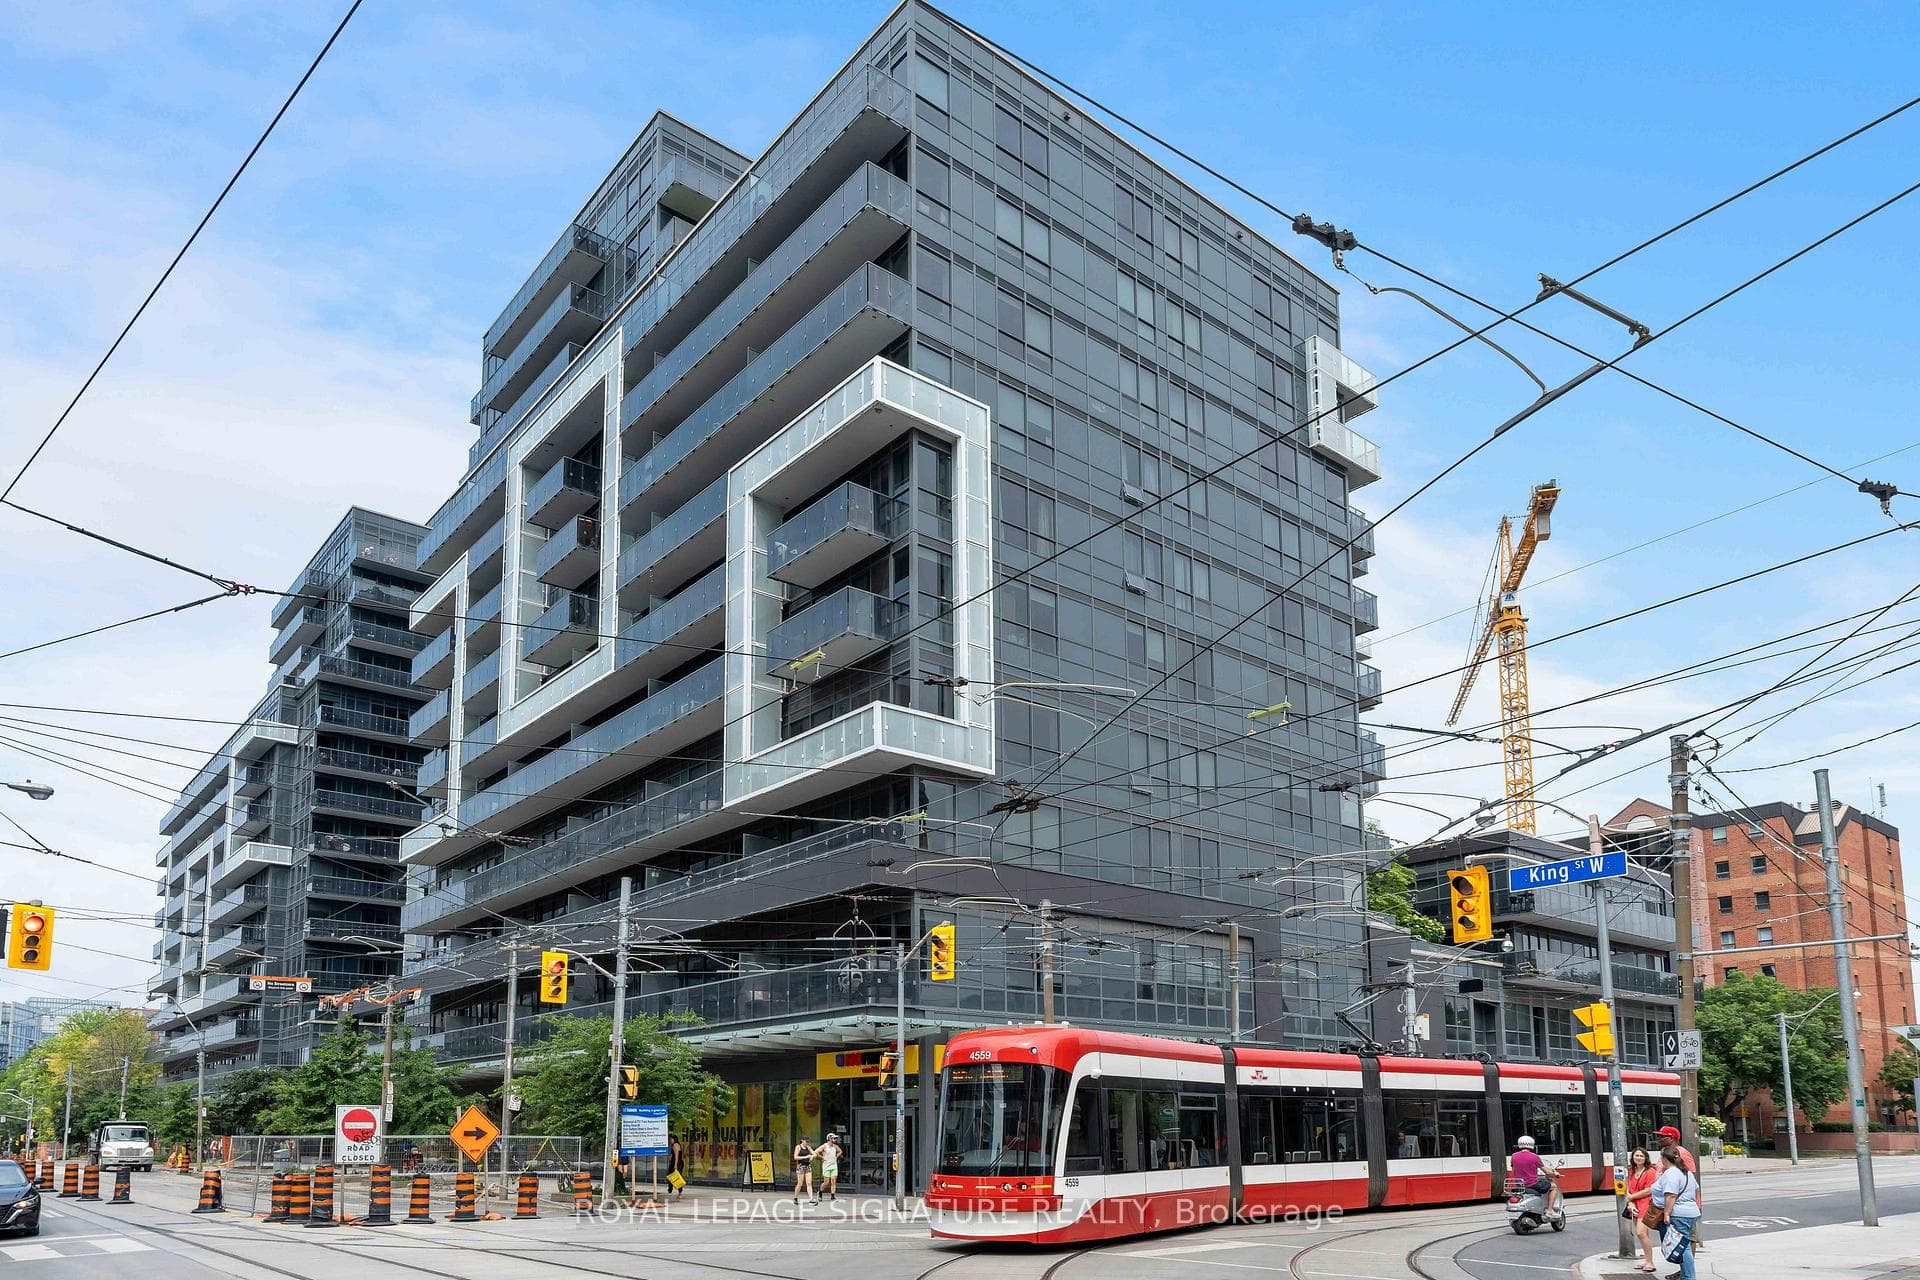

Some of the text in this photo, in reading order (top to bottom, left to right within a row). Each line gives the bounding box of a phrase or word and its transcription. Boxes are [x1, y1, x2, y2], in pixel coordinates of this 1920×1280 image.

[1529, 857, 1604, 882] King St W
[969, 1050, 992, 1060] 4559
[682, 1127, 708, 1142] HGH
[713, 1126, 764, 1142] UAITY.
[1065, 1177, 1080, 1188] 4559
